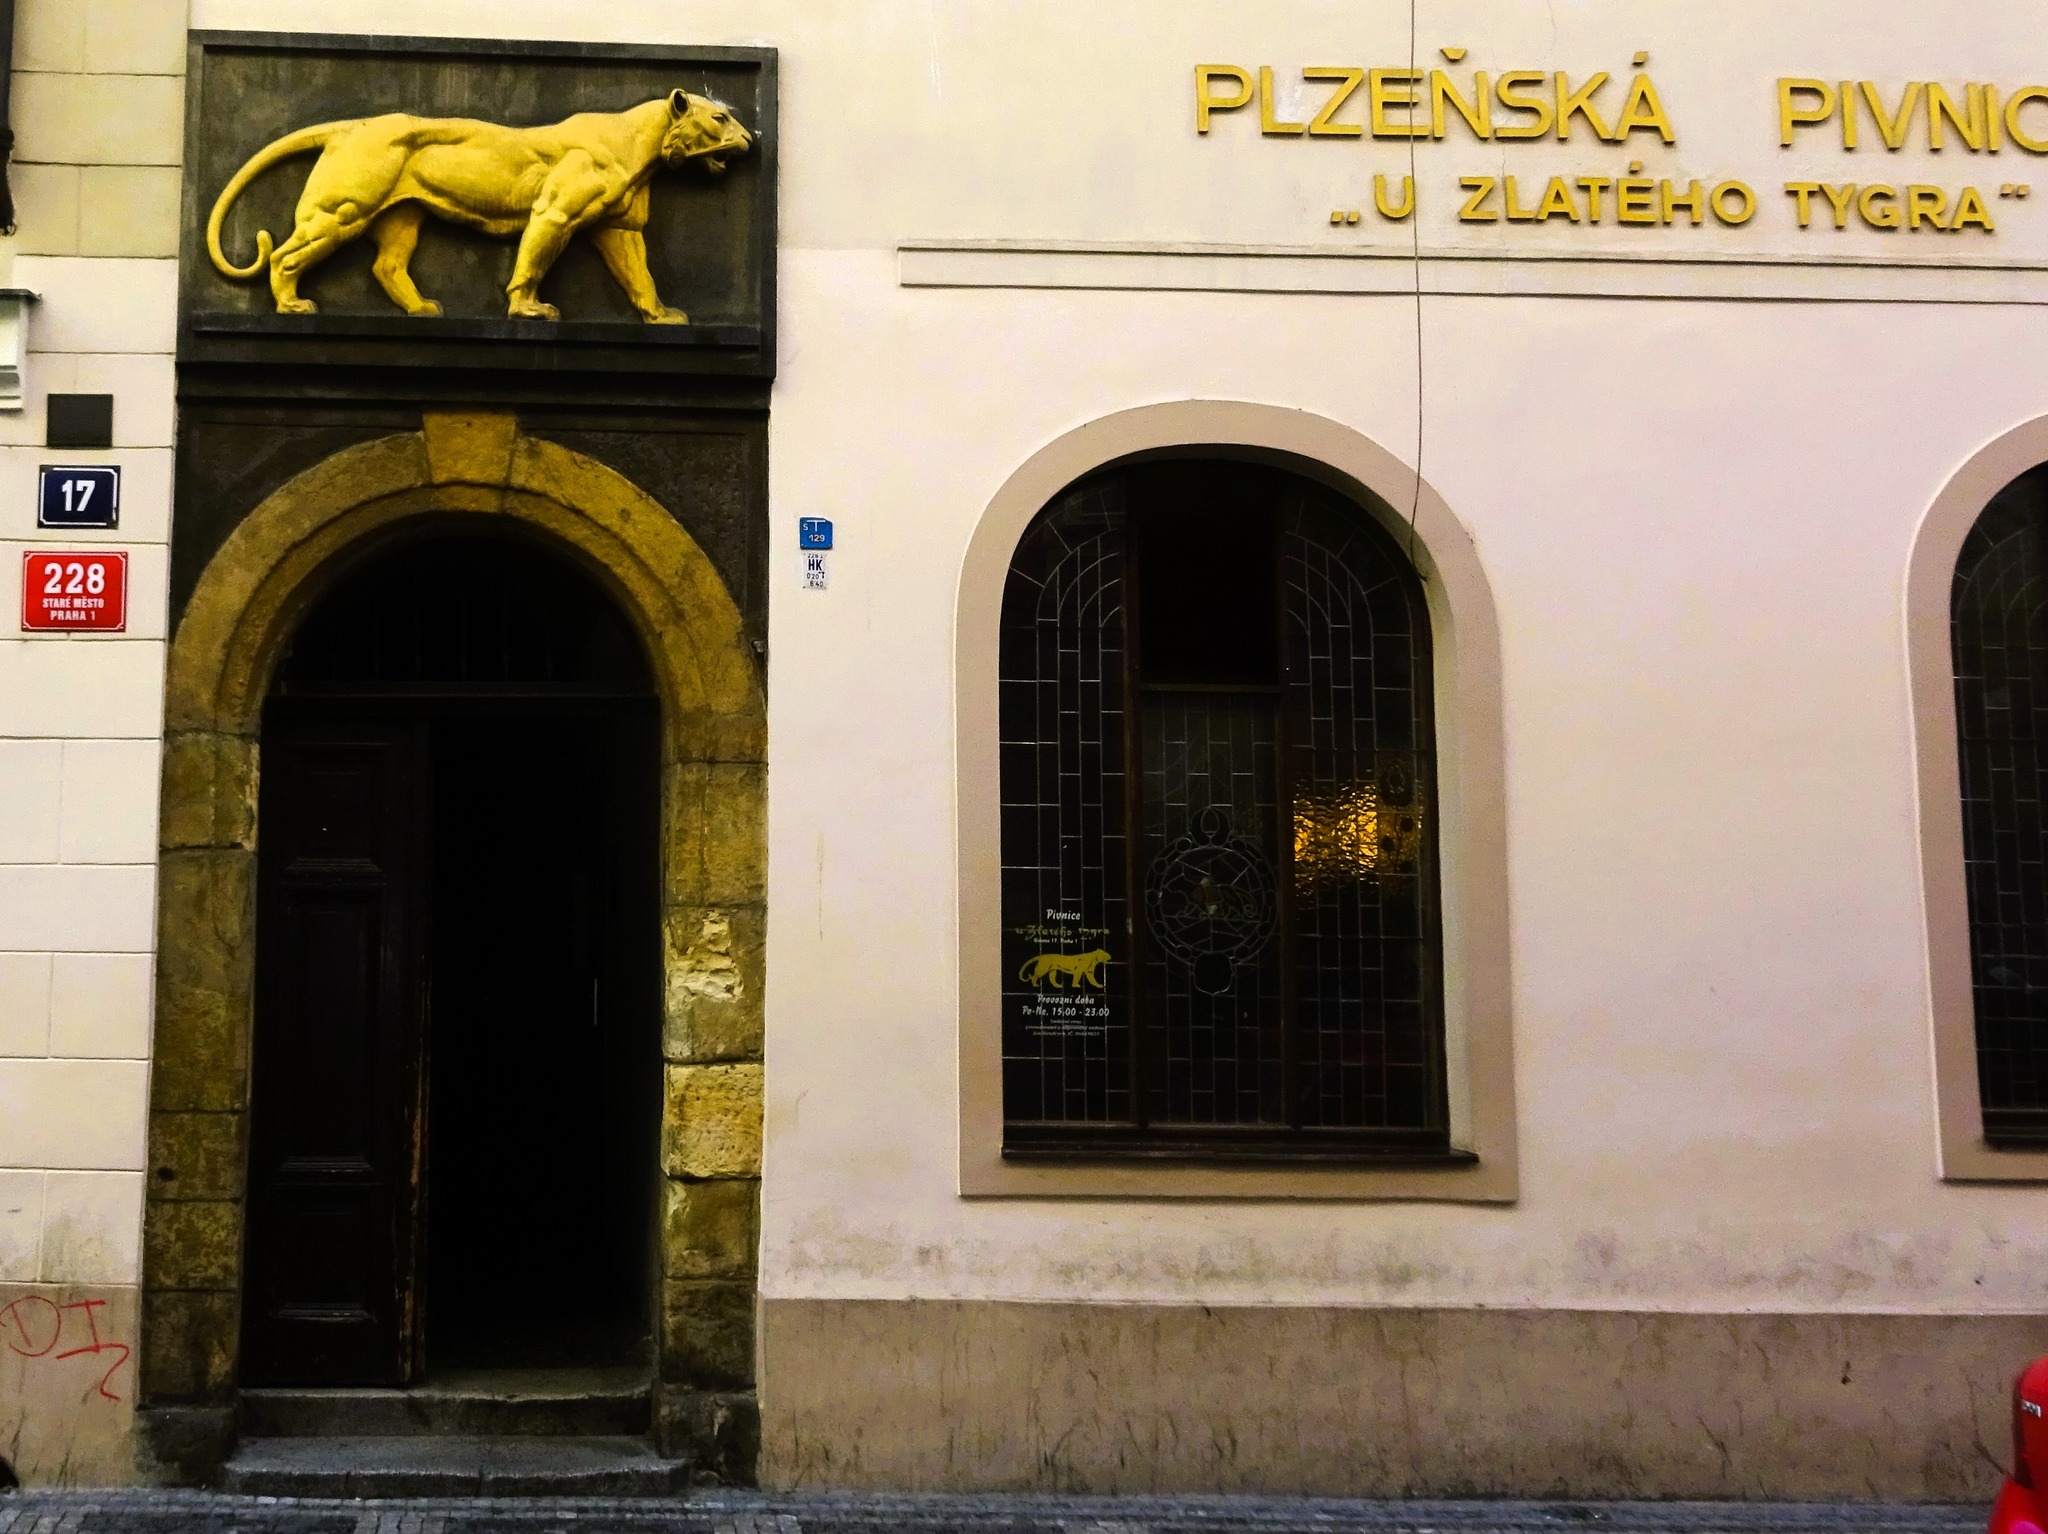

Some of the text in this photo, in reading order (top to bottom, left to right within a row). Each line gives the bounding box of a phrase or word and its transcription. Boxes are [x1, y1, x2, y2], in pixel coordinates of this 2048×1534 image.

[1195, 48, 1676, 144] PLZEŇSKÁ
[1458, 160, 1757, 226] ZLATÉHO
[61, 479, 96, 512] 17
[808, 559, 822, 571] HK
[43, 562, 105, 594] 228
[42, 595, 105, 608] STARÉ MĚSTO
[50, 610, 96, 621] PRAHA 1
[1046, 908, 1081, 921] Pivnice
[1074, 994, 1095, 1005] doba
